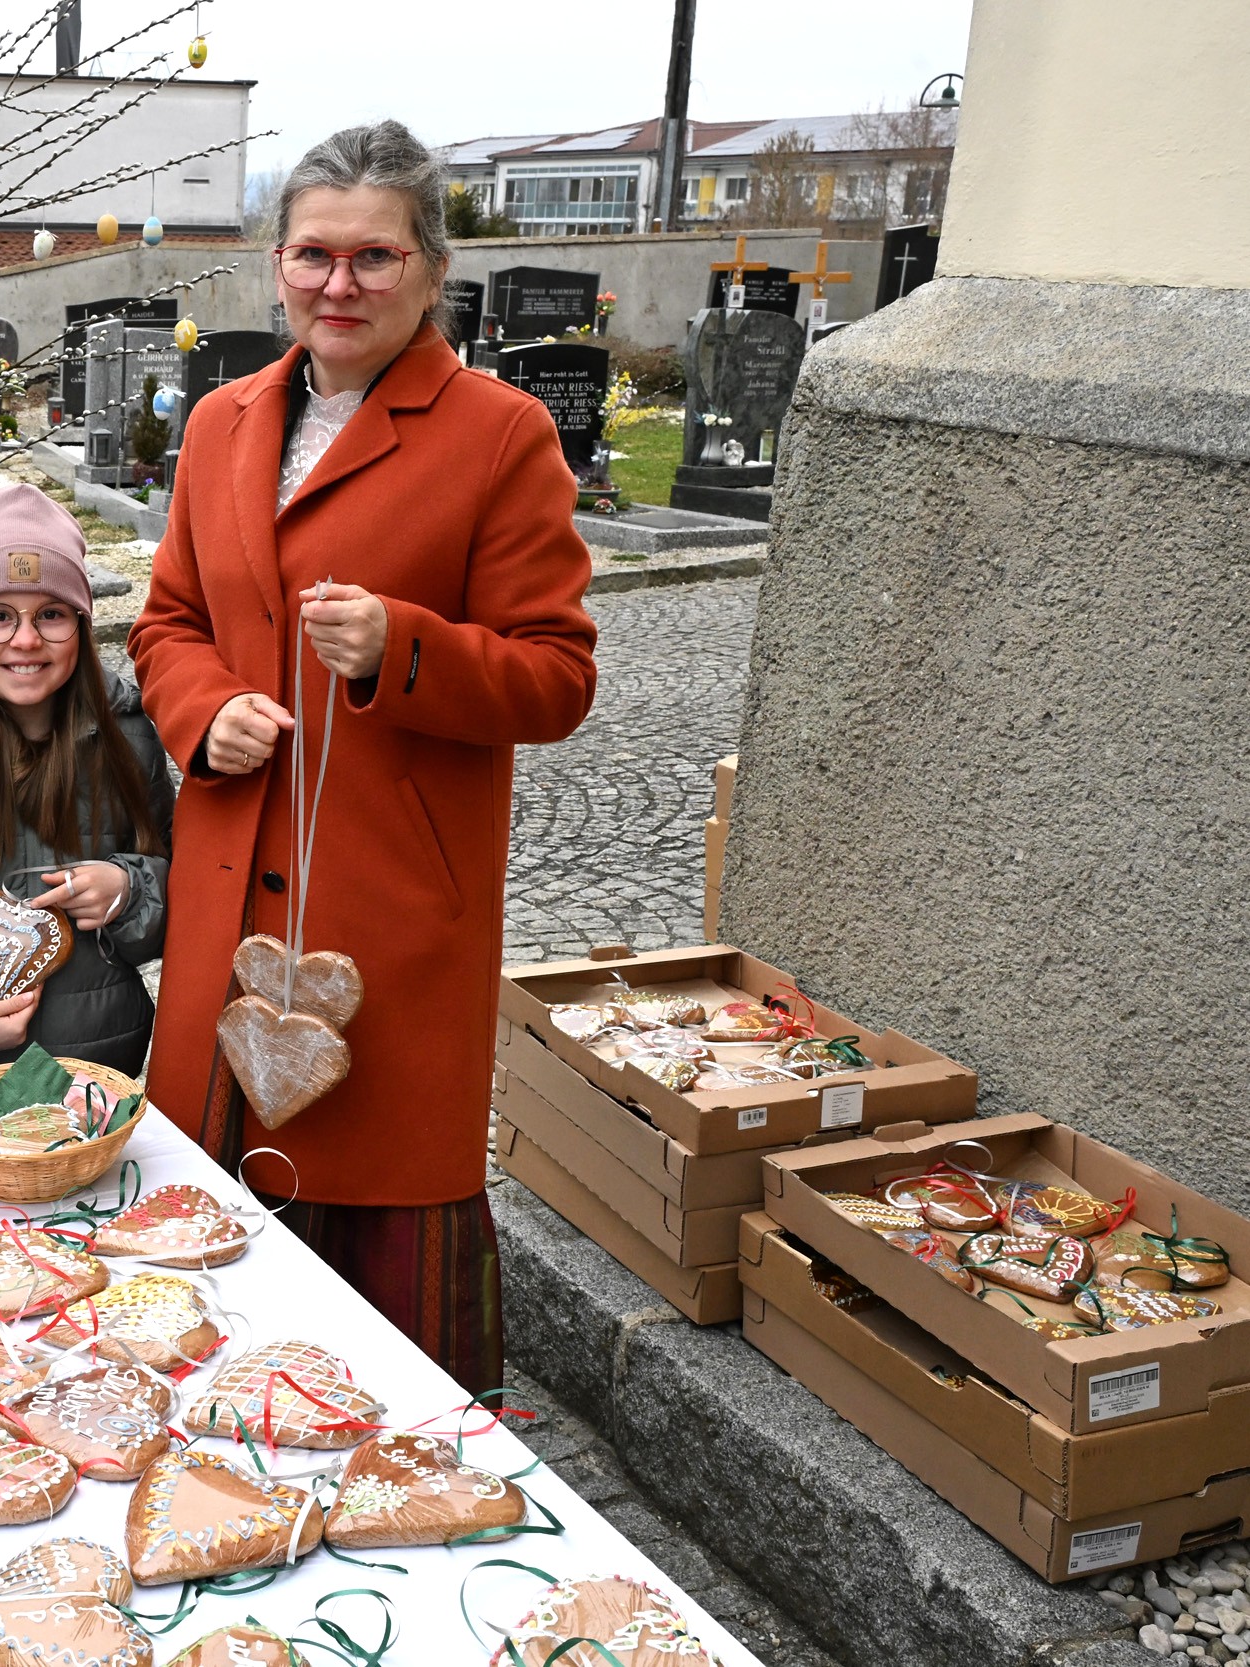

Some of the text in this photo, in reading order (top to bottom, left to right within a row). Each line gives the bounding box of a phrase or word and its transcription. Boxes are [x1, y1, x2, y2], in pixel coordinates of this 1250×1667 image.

[137, 354, 180, 362] GEIRHOFER
[530, 382, 595, 393] STEFAN RIESS
[573, 399, 597, 407] RIESS
[567, 414, 592, 424] RIESS
[1001, 1244, 1044, 1254] HERZI
[96, 1367, 140, 1403] Du
[23, 1387, 58, 1423] mir
